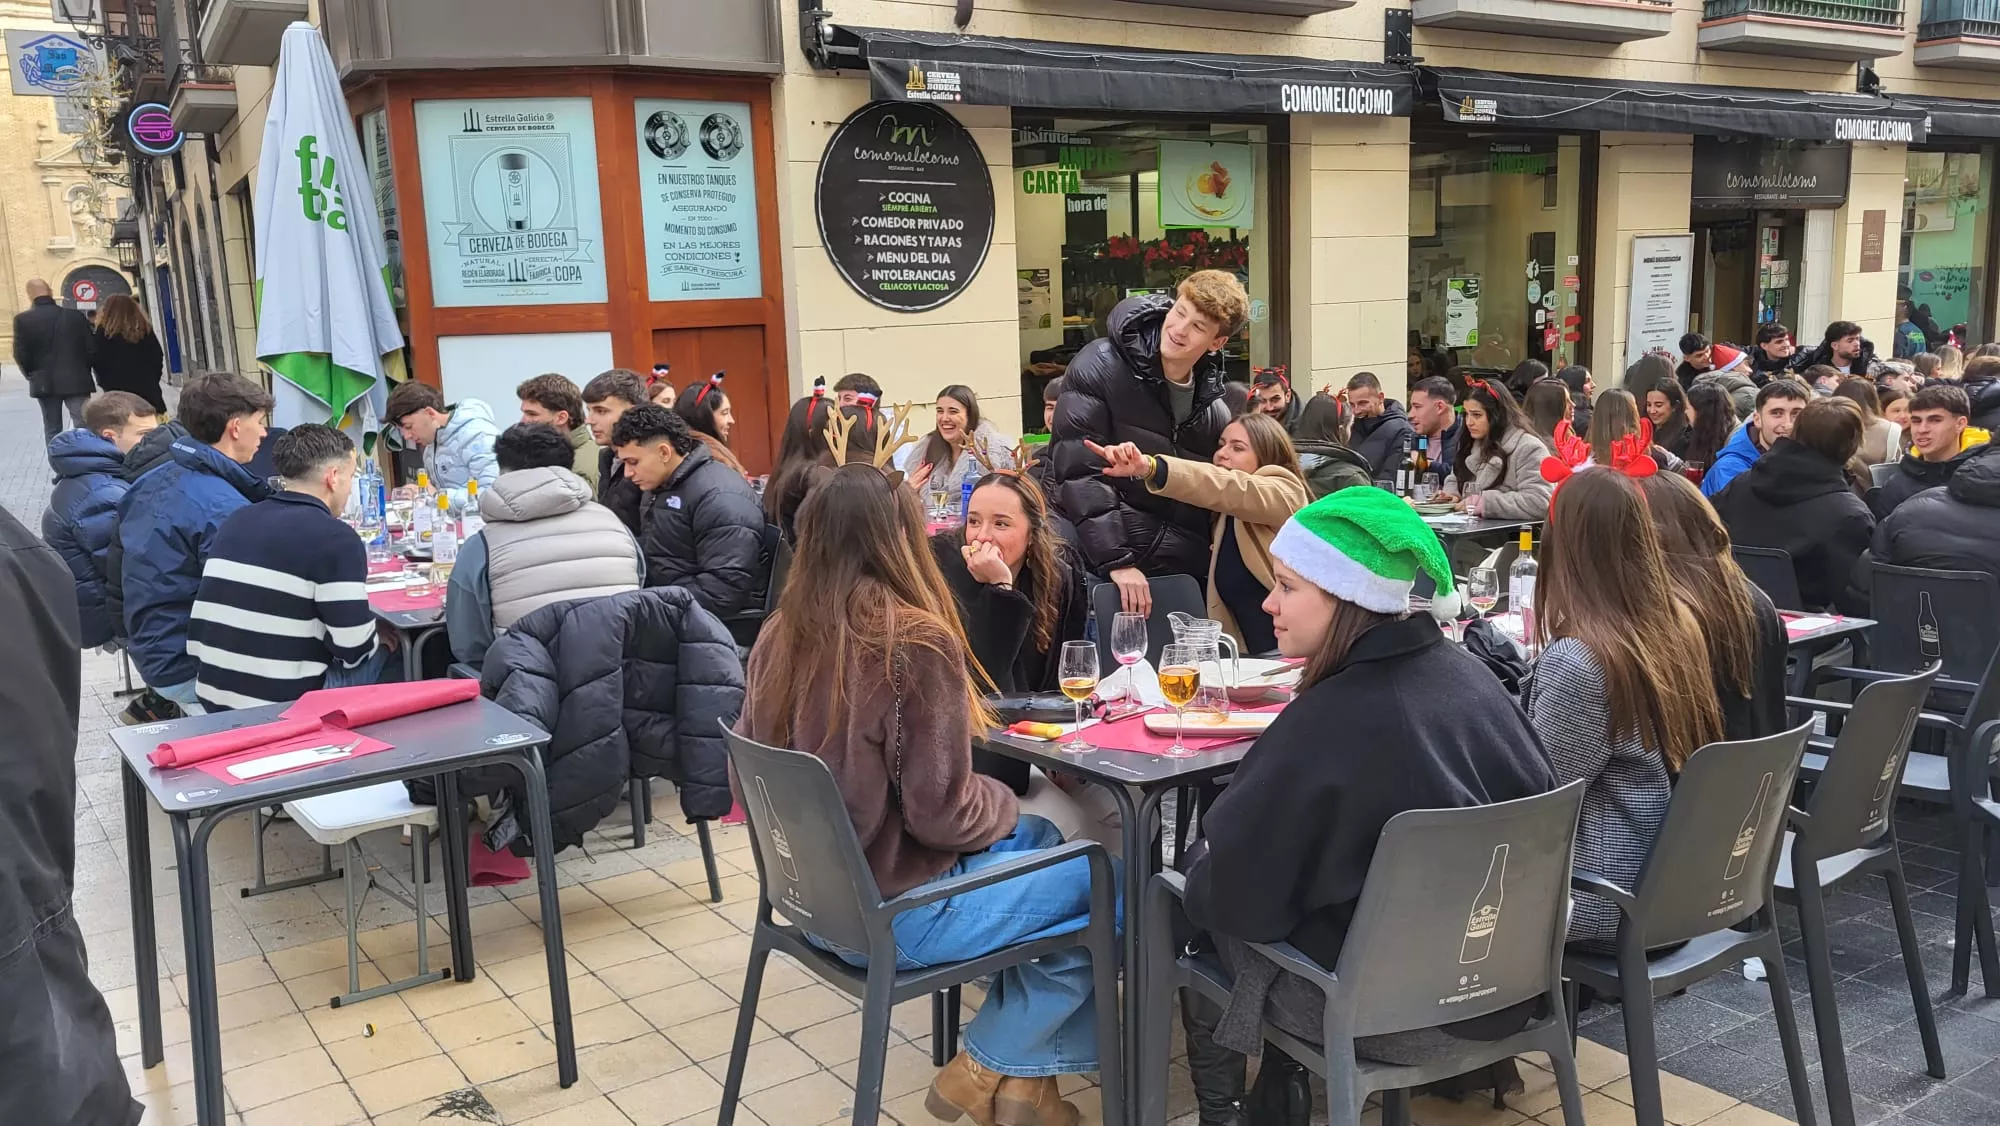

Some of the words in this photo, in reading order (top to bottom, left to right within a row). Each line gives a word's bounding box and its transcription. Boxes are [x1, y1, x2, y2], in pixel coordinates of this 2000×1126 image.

[927, 83, 961, 91] BODEGA
[907, 91, 930, 99] Estrella
[931, 92, 953, 100] Galicia
[1281, 84, 1393, 115] COMOMELOCOMO
[485, 114, 515, 122] Estrella
[517, 113, 545, 121] Galicia
[1835, 118, 1912, 142] COMOMELOCOMO
[854, 145, 960, 165] comomelocomo
[658, 173, 668, 185] EN
[668, 173, 705, 186] NUESTROS
[706, 174, 737, 186] TANQUES
[1023, 170, 1080, 194] CARTA
[1726, 166, 1817, 188] comomelocomo
[660, 193, 669, 203] SE
[669, 189, 702, 201] CONSERVA
[703, 190, 737, 204] PROTEGIDO
[888, 192, 931, 204] COCINA
[882, 204, 909, 212] SIEMPRE
[910, 205, 937, 213] ABIERTA
[1067, 197, 1092, 213] hora
[1093, 196, 1107, 211] de
[664, 222, 696, 236] MOMENTO
[697, 226, 706, 236] SU
[706, 222, 738, 236] CONSUMO
[861, 216, 916, 229] COMEDOR
[917, 219, 964, 230] PRIVADO
[469, 236, 514, 254] CERVEZA
[515, 235, 526, 249] DE
[527, 231, 568, 249] BODEGA
[663, 242, 676, 250] EN
[679, 242, 697, 250] LAS
[699, 241, 741, 249] MEJORES
[864, 234, 918, 247] RACIONES
[919, 236, 926, 247] Y
[927, 236, 962, 248] TAPAS
[463, 257, 502, 267] NATURAL
[664, 252, 732, 261] CONDICIONES
[877, 252, 908, 263] MENU
[910, 253, 929, 264] DEL
[931, 253, 951, 264] DIA
[554, 265, 583, 281] COPA
[871, 269, 956, 281] INTOLERANCIAS
[880, 282, 913, 290] CELIACOS
[1471, 913, 1496, 923] Estrella
[1470, 921, 1493, 931] Galicia
